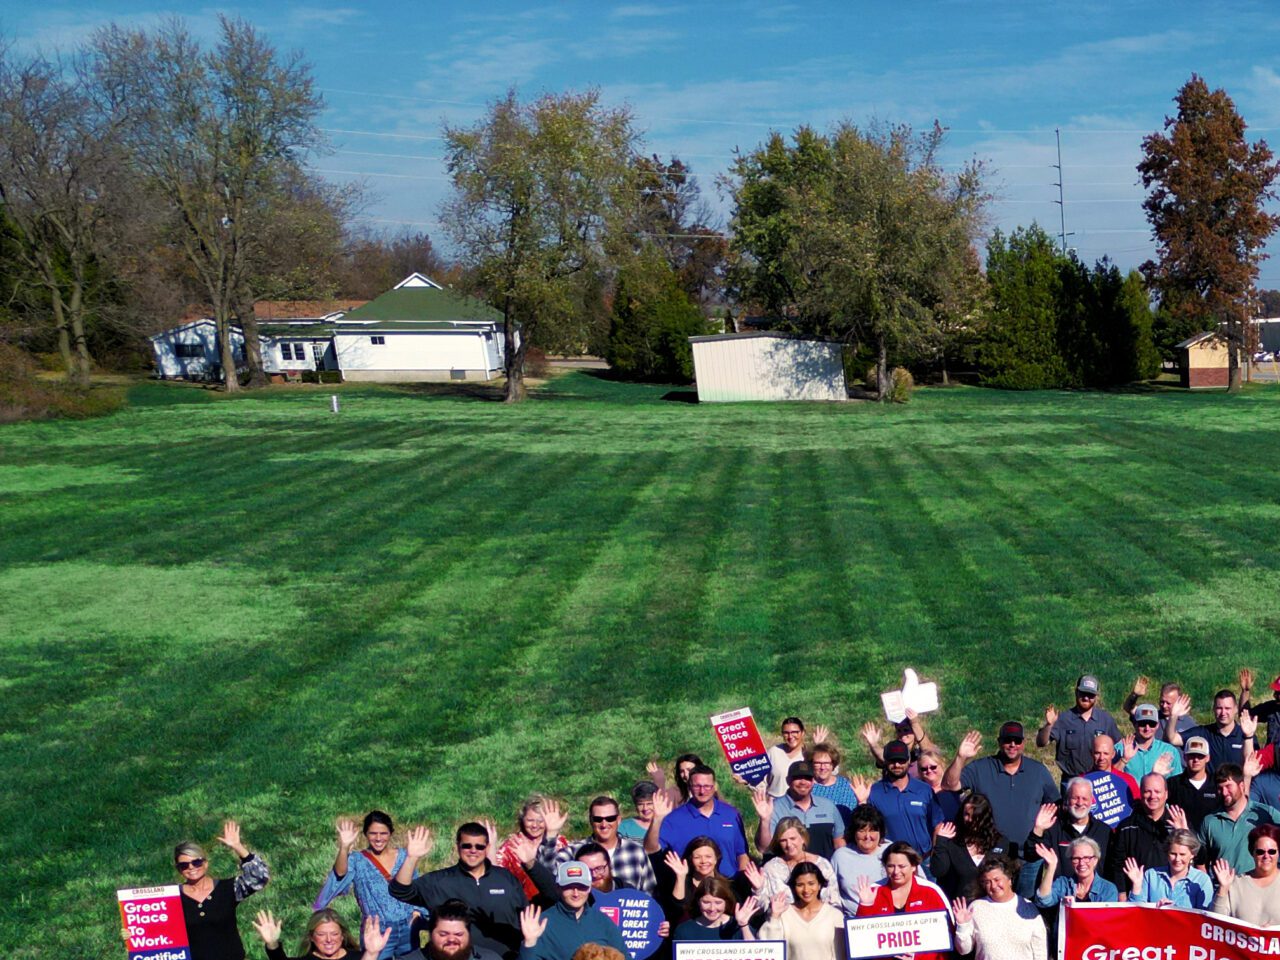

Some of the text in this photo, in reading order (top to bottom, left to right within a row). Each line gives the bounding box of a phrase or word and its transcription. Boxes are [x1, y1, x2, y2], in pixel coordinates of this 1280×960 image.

[718, 721, 745, 733] Great
[722, 730, 748, 742] Place
[734, 756, 767, 770] Certified
[1093, 775, 1111, 786] MAKE
[1094, 785, 1109, 794] THIS
[1098, 790, 1118, 802] GREAT
[1101, 797, 1121, 809] PLACE
[124, 901, 167, 913] Great
[626, 900, 650, 908] MAKE
[127, 913, 168, 924] Place
[623, 910, 641, 918] THIS
[623, 920, 649, 928] GREAT
[128, 926, 145, 936] To
[622, 930, 648, 938] PLACE
[625, 941, 650, 949] ORK!"
[877, 930, 921, 949] PRIDE
